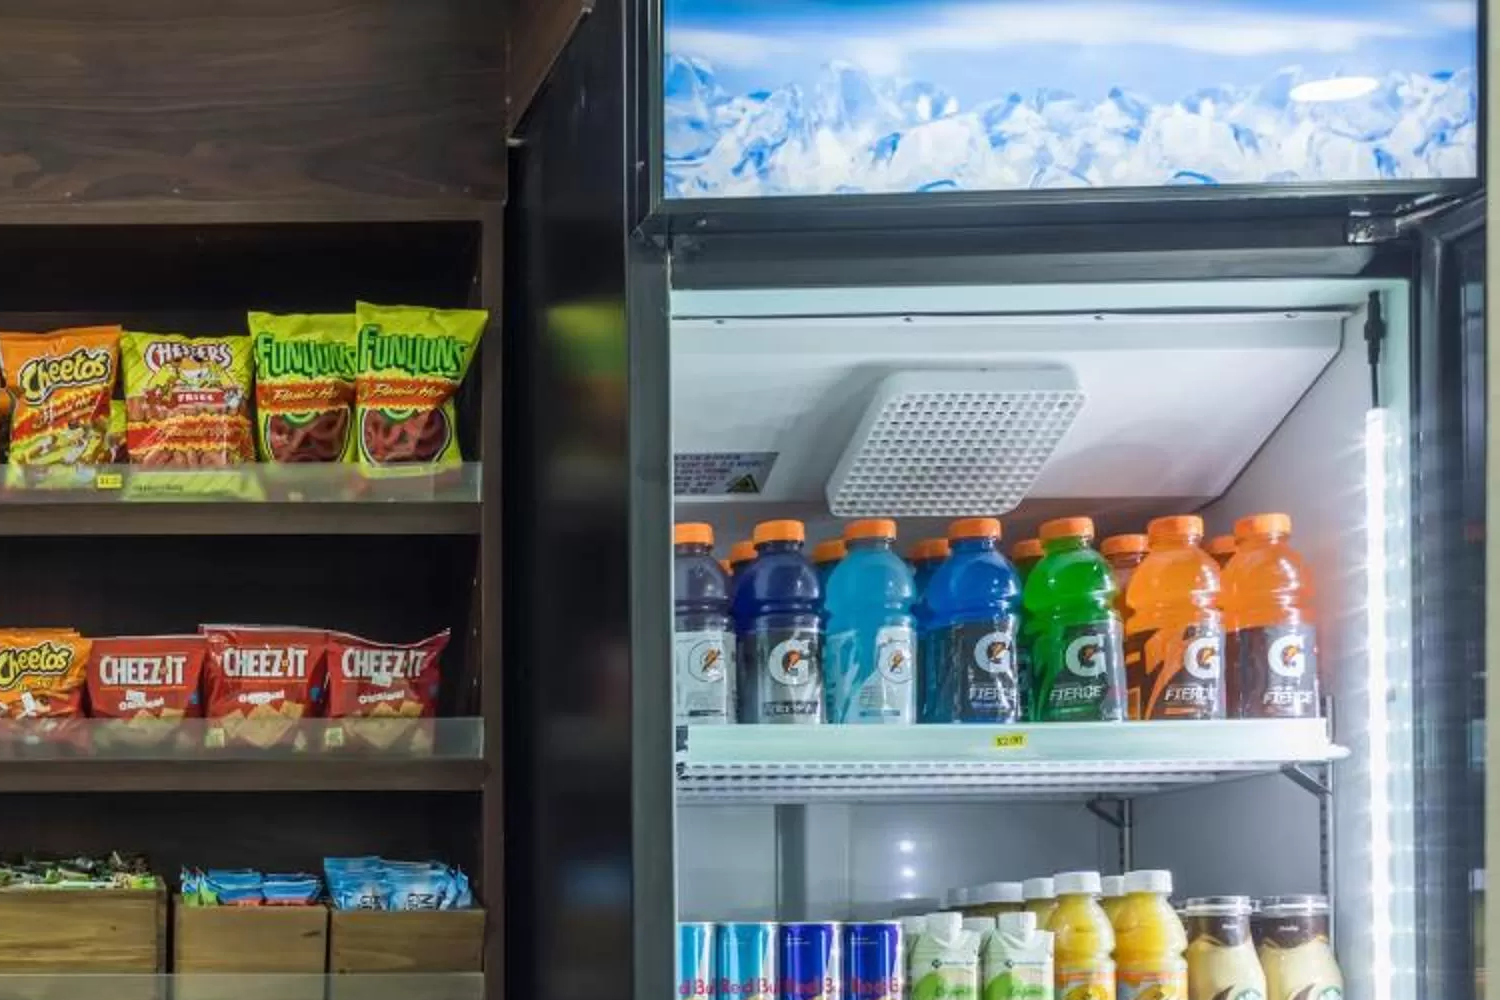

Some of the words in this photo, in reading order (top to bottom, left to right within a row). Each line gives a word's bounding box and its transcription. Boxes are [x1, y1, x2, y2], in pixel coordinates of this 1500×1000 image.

[21, 349, 110, 400] Cheetos
[1066, 634, 1106, 677] G
[1183, 636, 1220, 679] G
[1268, 633, 1305, 677] G
